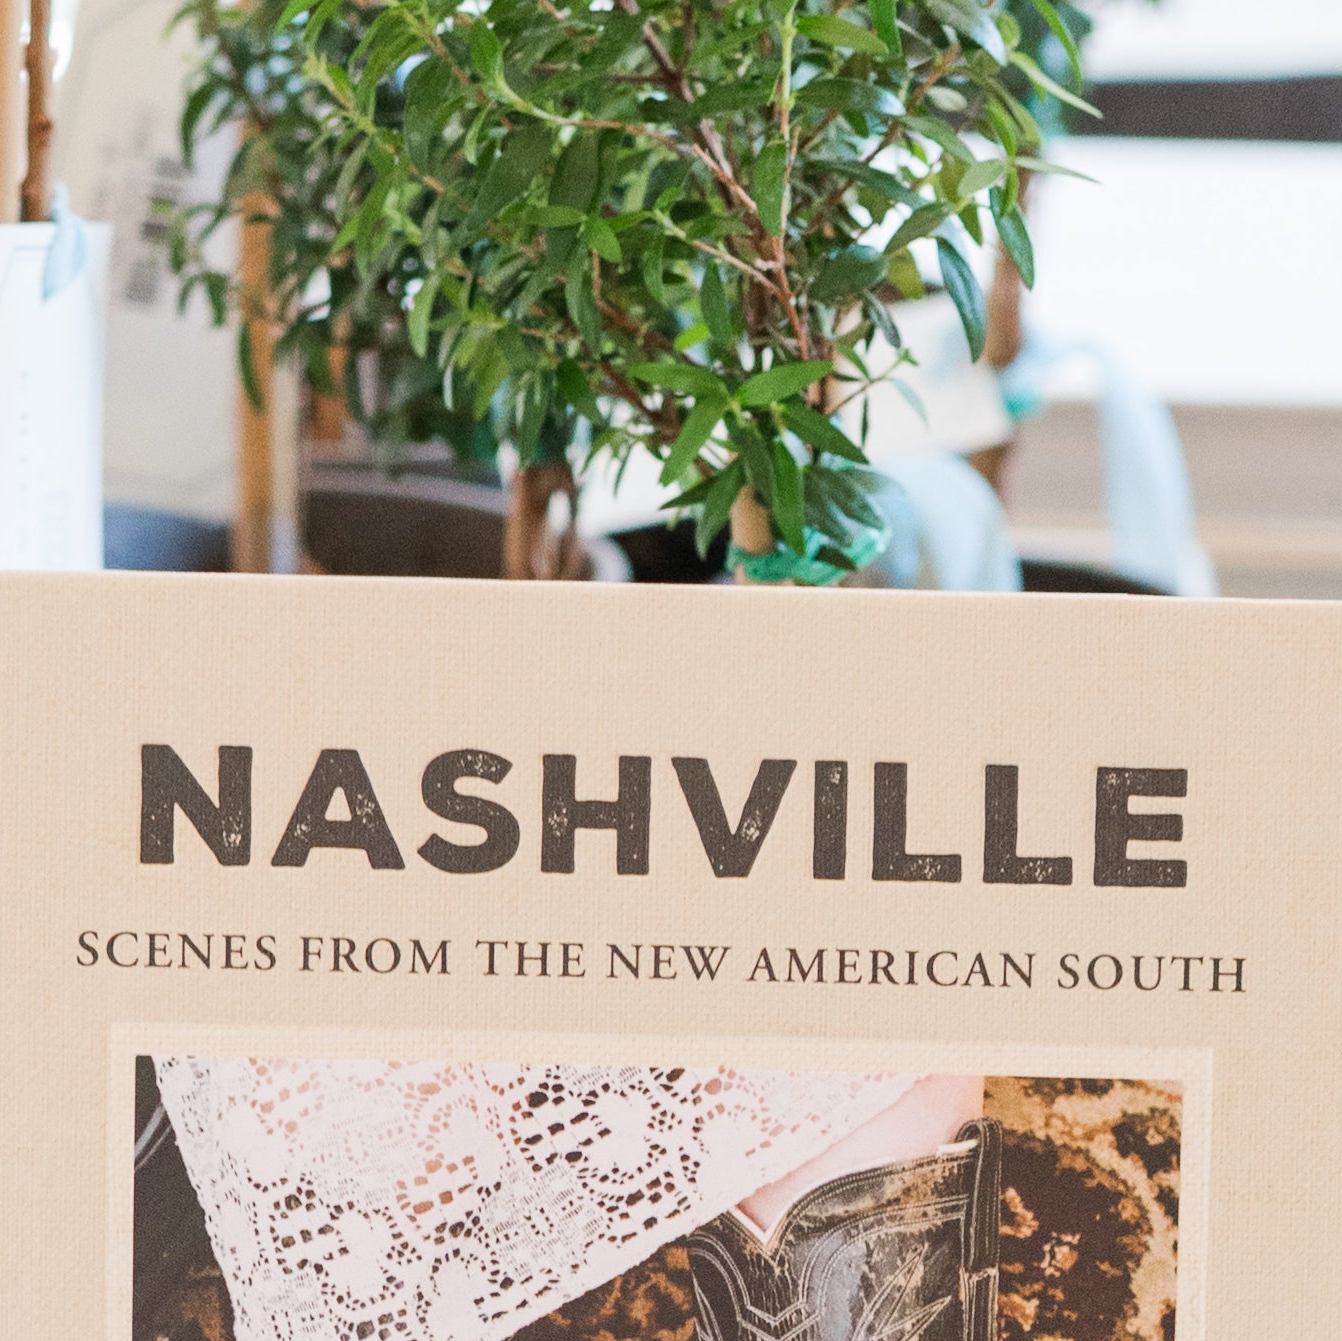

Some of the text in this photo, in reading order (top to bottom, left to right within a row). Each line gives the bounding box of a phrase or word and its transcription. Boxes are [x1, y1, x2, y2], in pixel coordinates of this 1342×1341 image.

[138, 742, 1189, 890] NASHVILLE
[75, 929, 1247, 994] SCENES FROM THE NEW AMERICAN SOUTH
